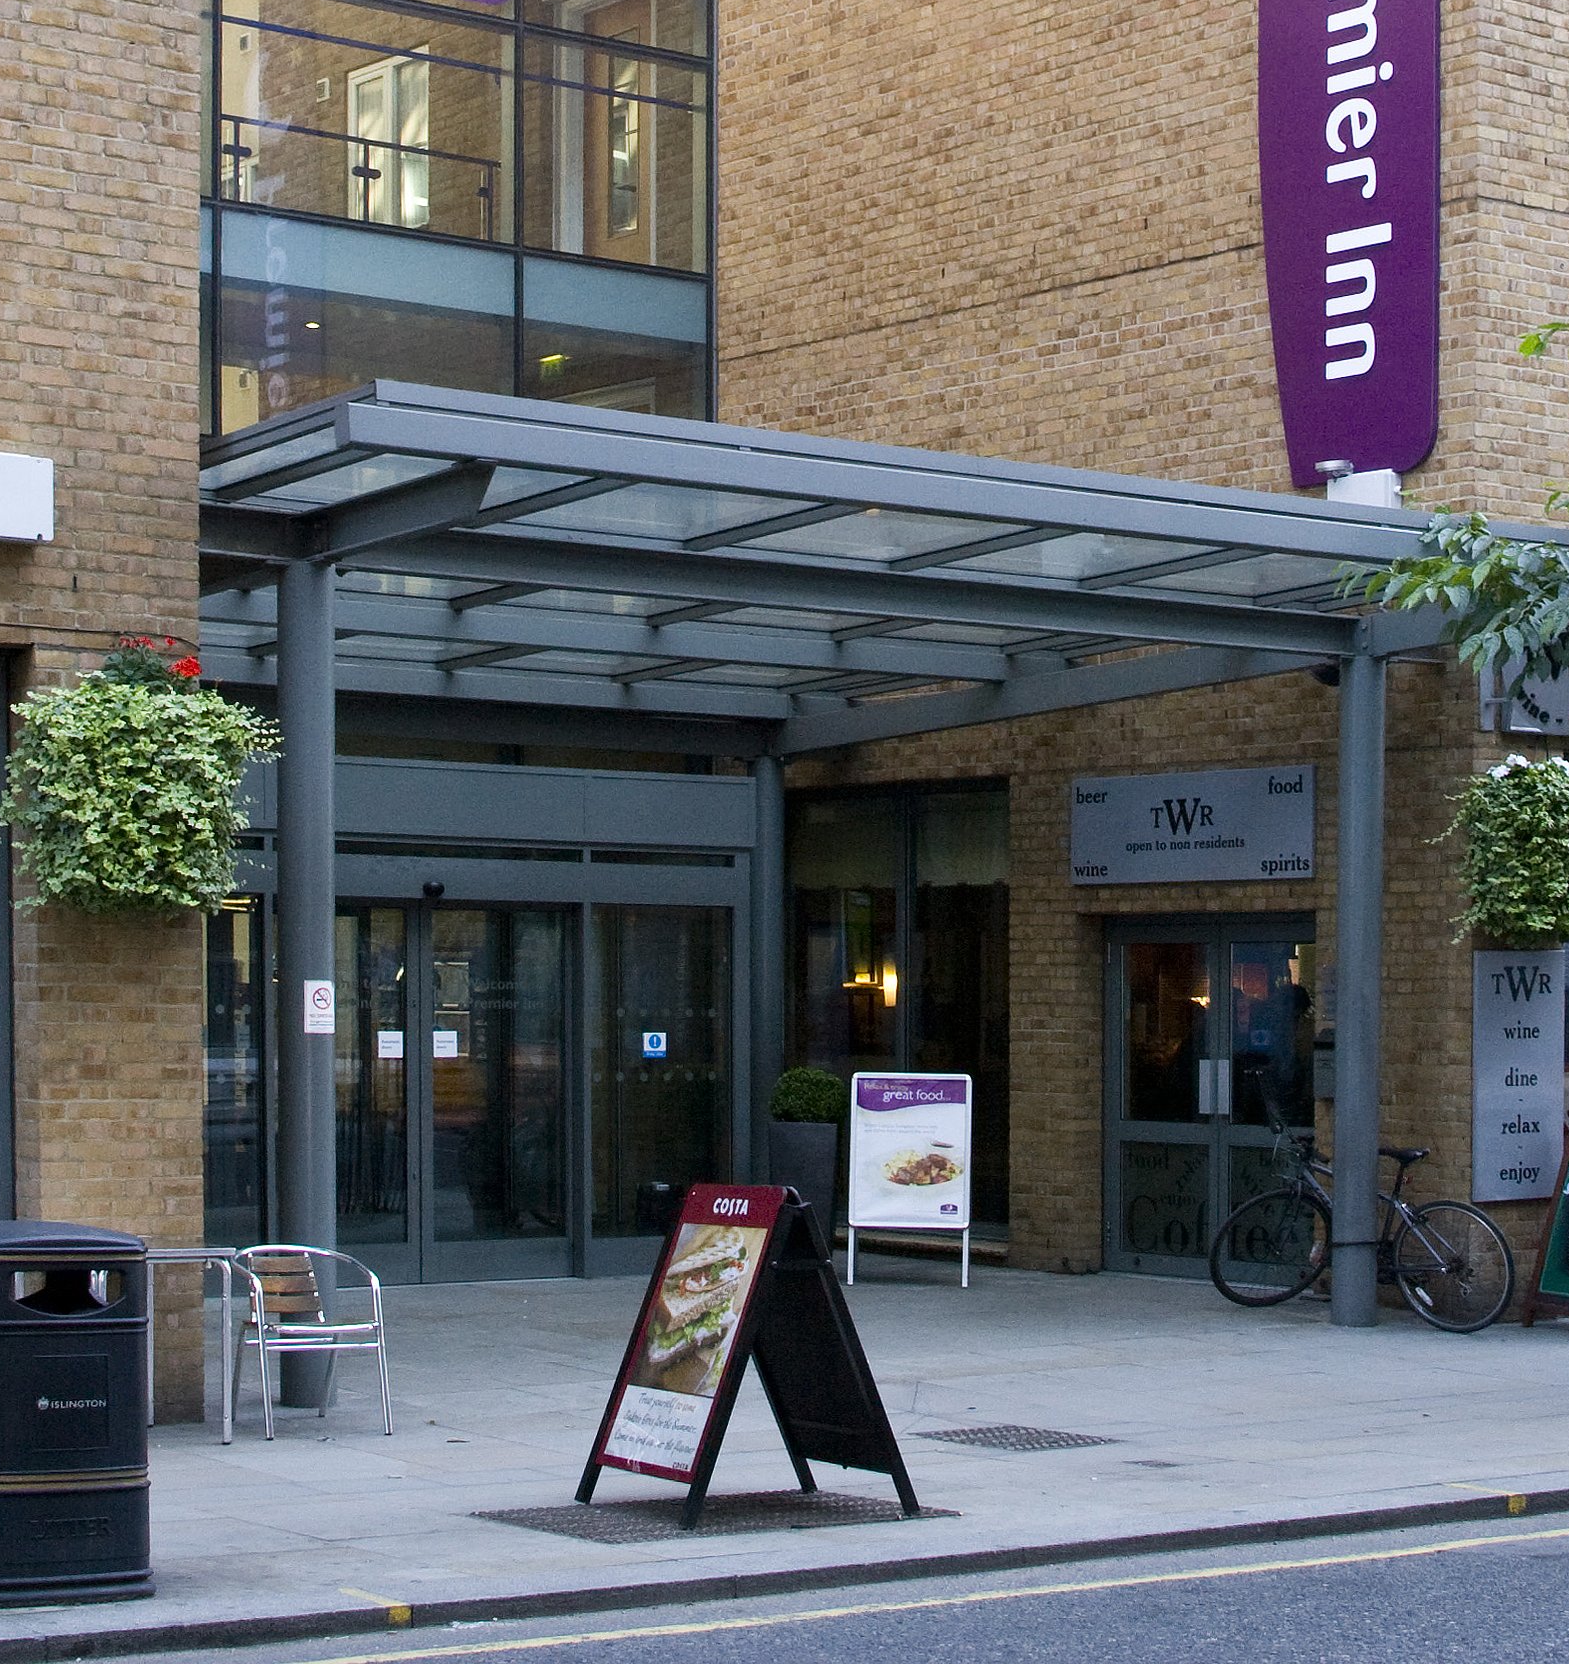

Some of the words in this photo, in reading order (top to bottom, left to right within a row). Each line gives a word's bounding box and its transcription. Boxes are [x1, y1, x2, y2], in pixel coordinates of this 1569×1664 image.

[1324, 219, 1393, 382] Inn
[1267, 774, 1304, 795] food
[1076, 787, 1108, 804] beer
[1125, 840, 1153, 855] open
[1155, 839, 1168, 851] to
[1169, 839, 1191, 851] non
[1194, 835, 1246, 851] residents
[1074, 860, 1109, 878] wine
[1260, 853, 1311, 876] spirits
[1504, 1020, 1540, 1040] wine
[1504, 1067, 1538, 1087] dine
[882, 1090, 914, 1103] great
[1501, 1114, 1541, 1135] relax
[1500, 1161, 1540, 1185] enjoy
[713, 1197, 749, 1217] COSTA
[50, 1399, 107, 1410] ISLINGTON
